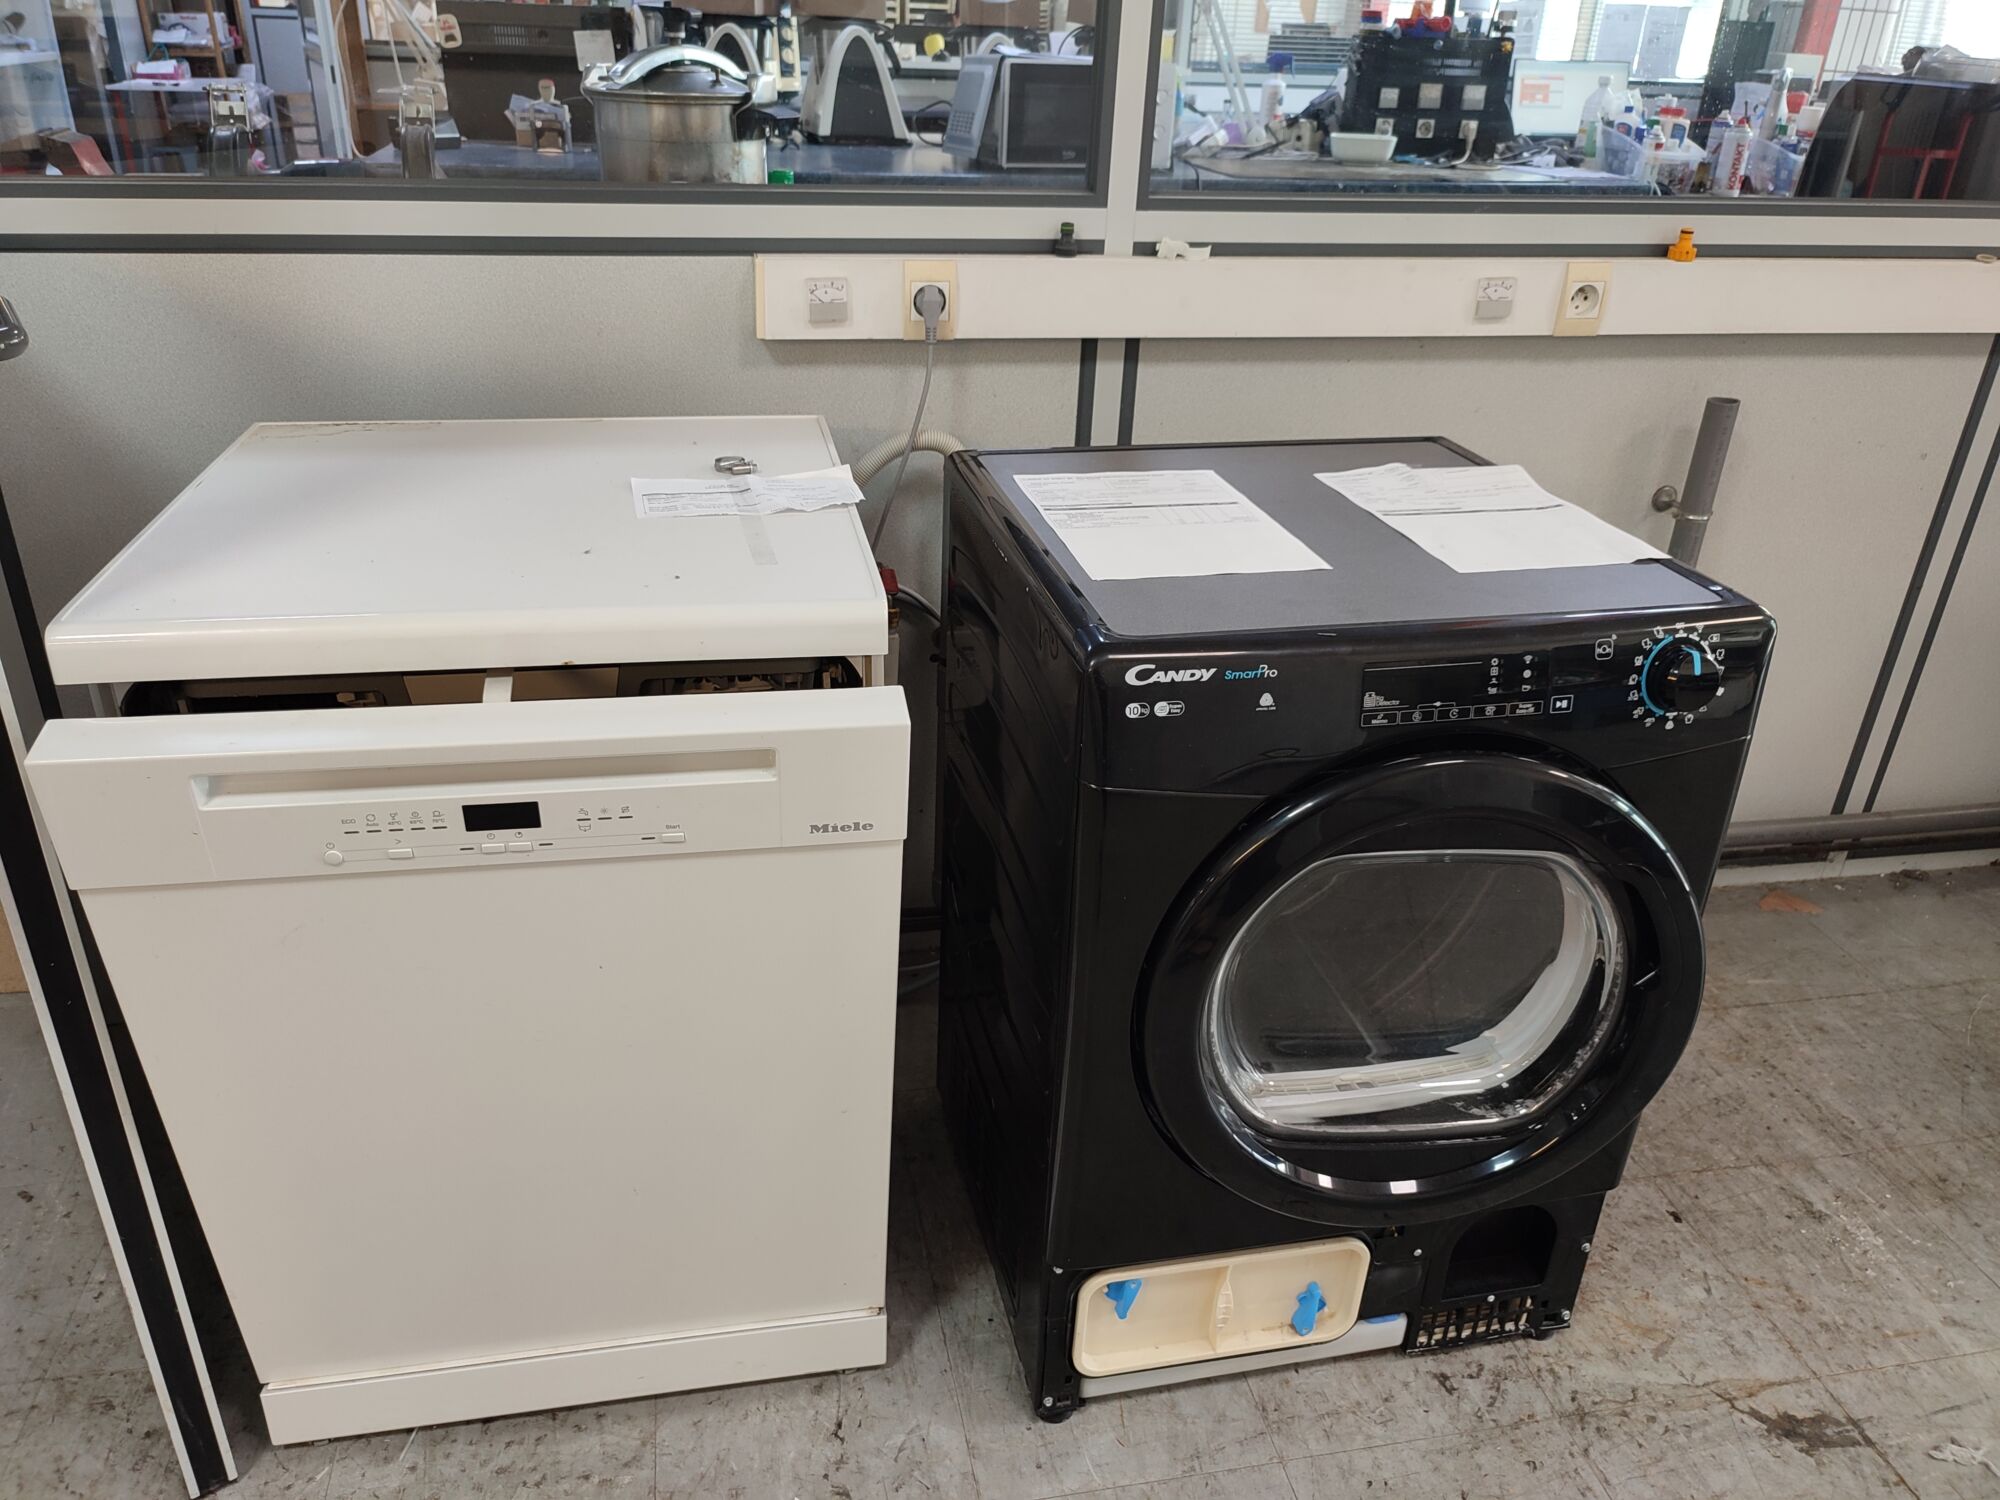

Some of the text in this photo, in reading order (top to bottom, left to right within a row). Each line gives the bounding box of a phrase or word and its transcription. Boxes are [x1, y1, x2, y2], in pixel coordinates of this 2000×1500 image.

[1727, 142, 1745, 190] KONTAKT
[1124, 663, 1218, 686] CANDY
[1127, 706, 1139, 716] 10
[809, 821, 874, 834] Miele
